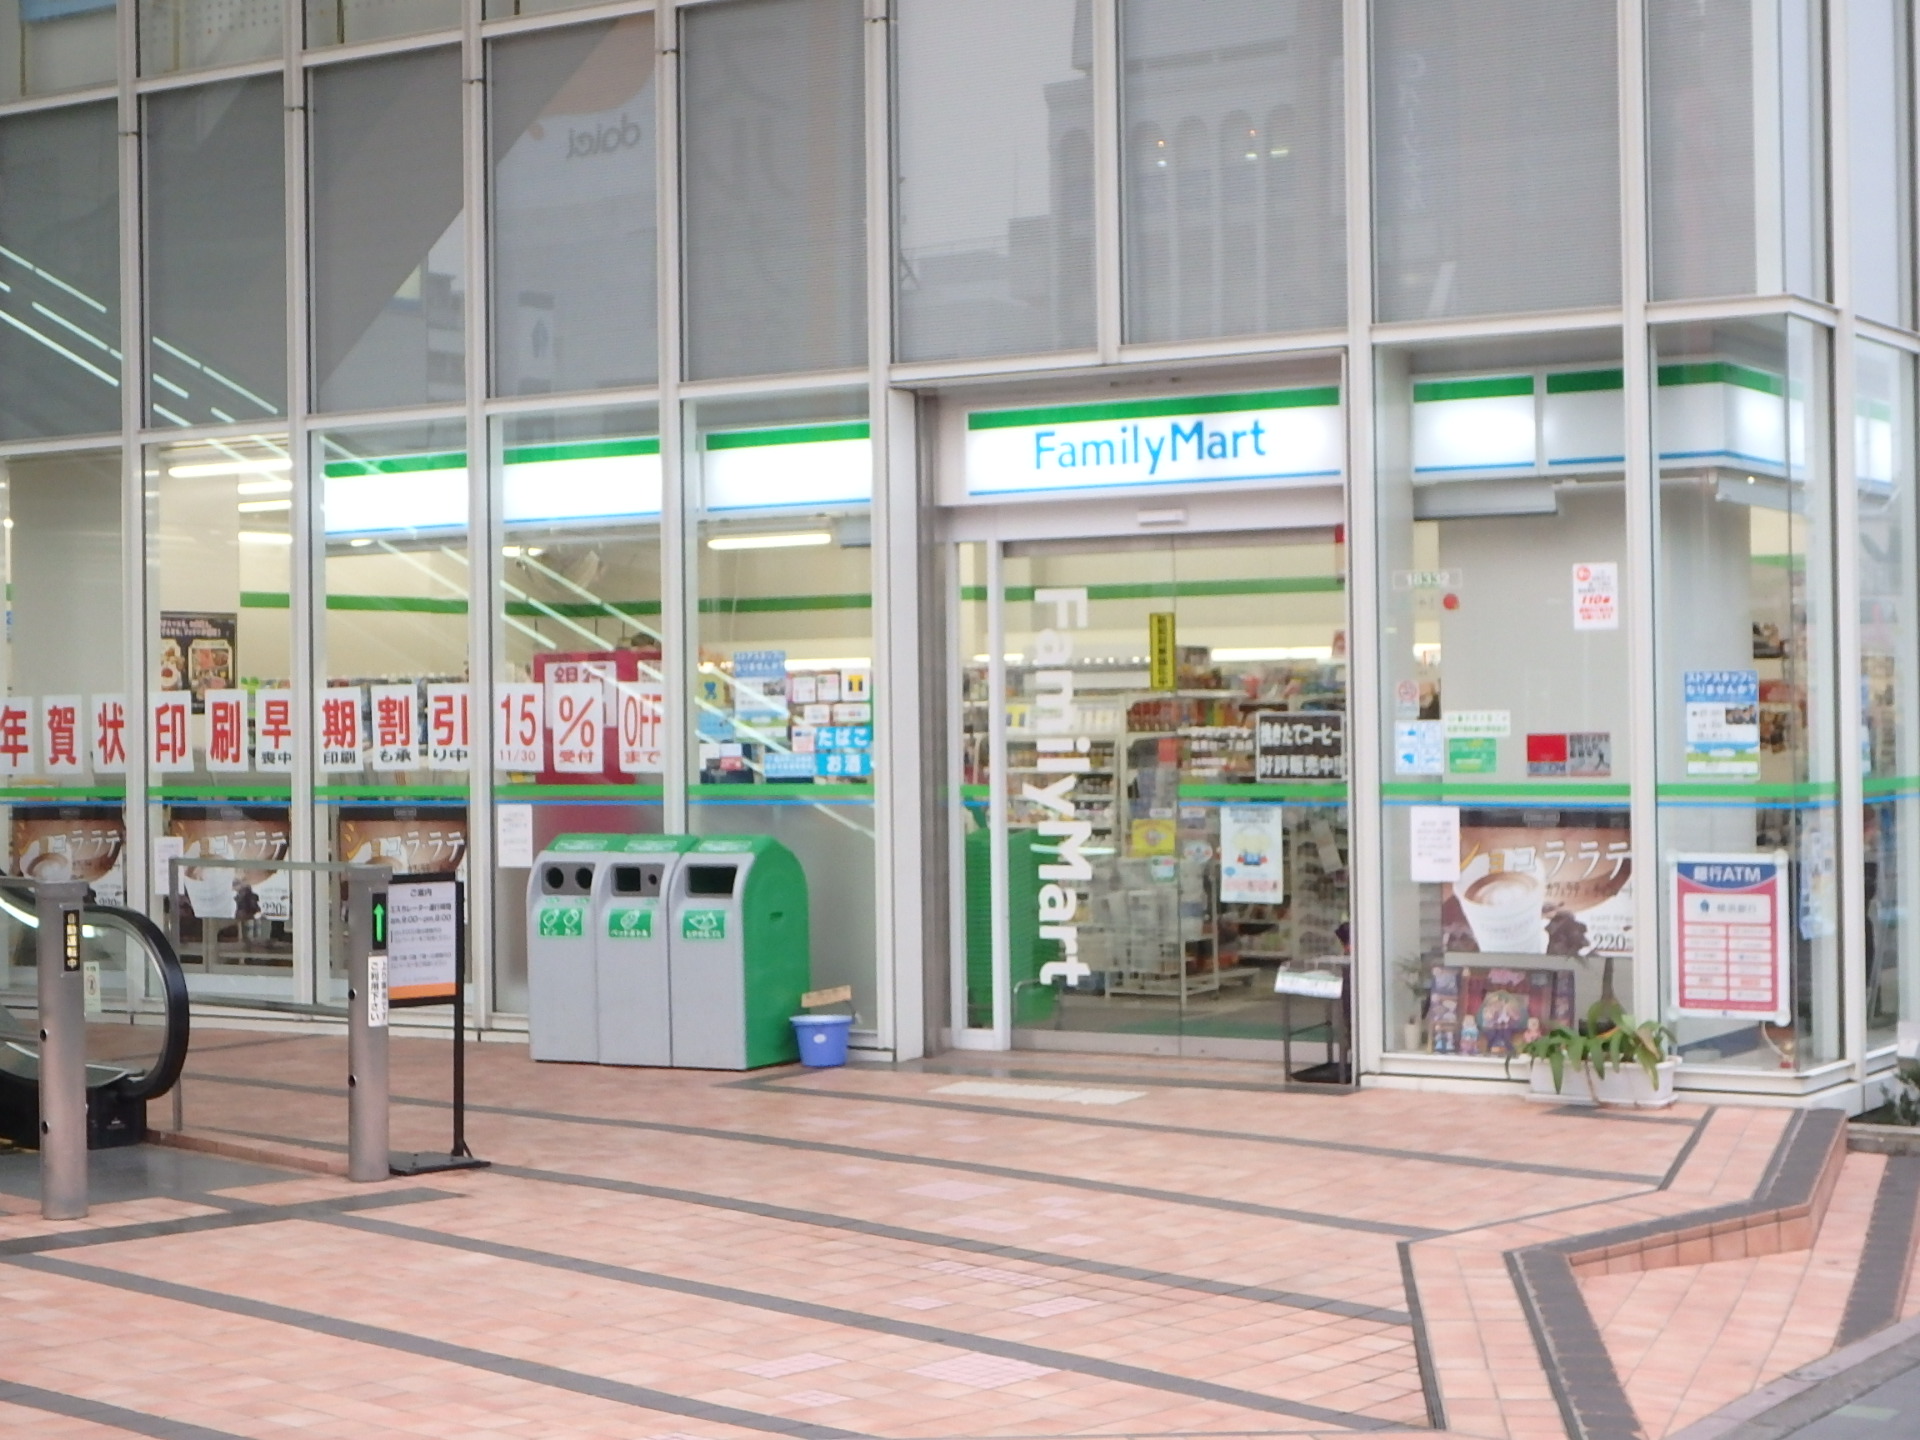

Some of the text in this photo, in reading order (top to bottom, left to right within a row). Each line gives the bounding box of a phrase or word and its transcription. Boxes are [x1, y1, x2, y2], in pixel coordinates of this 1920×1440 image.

[1034, 418, 1266, 476] FamilyMart
[818, 728, 868, 747] たばこ
[826, 755, 861, 774] お酒
[1022, 586, 1093, 987] FamilyMart
